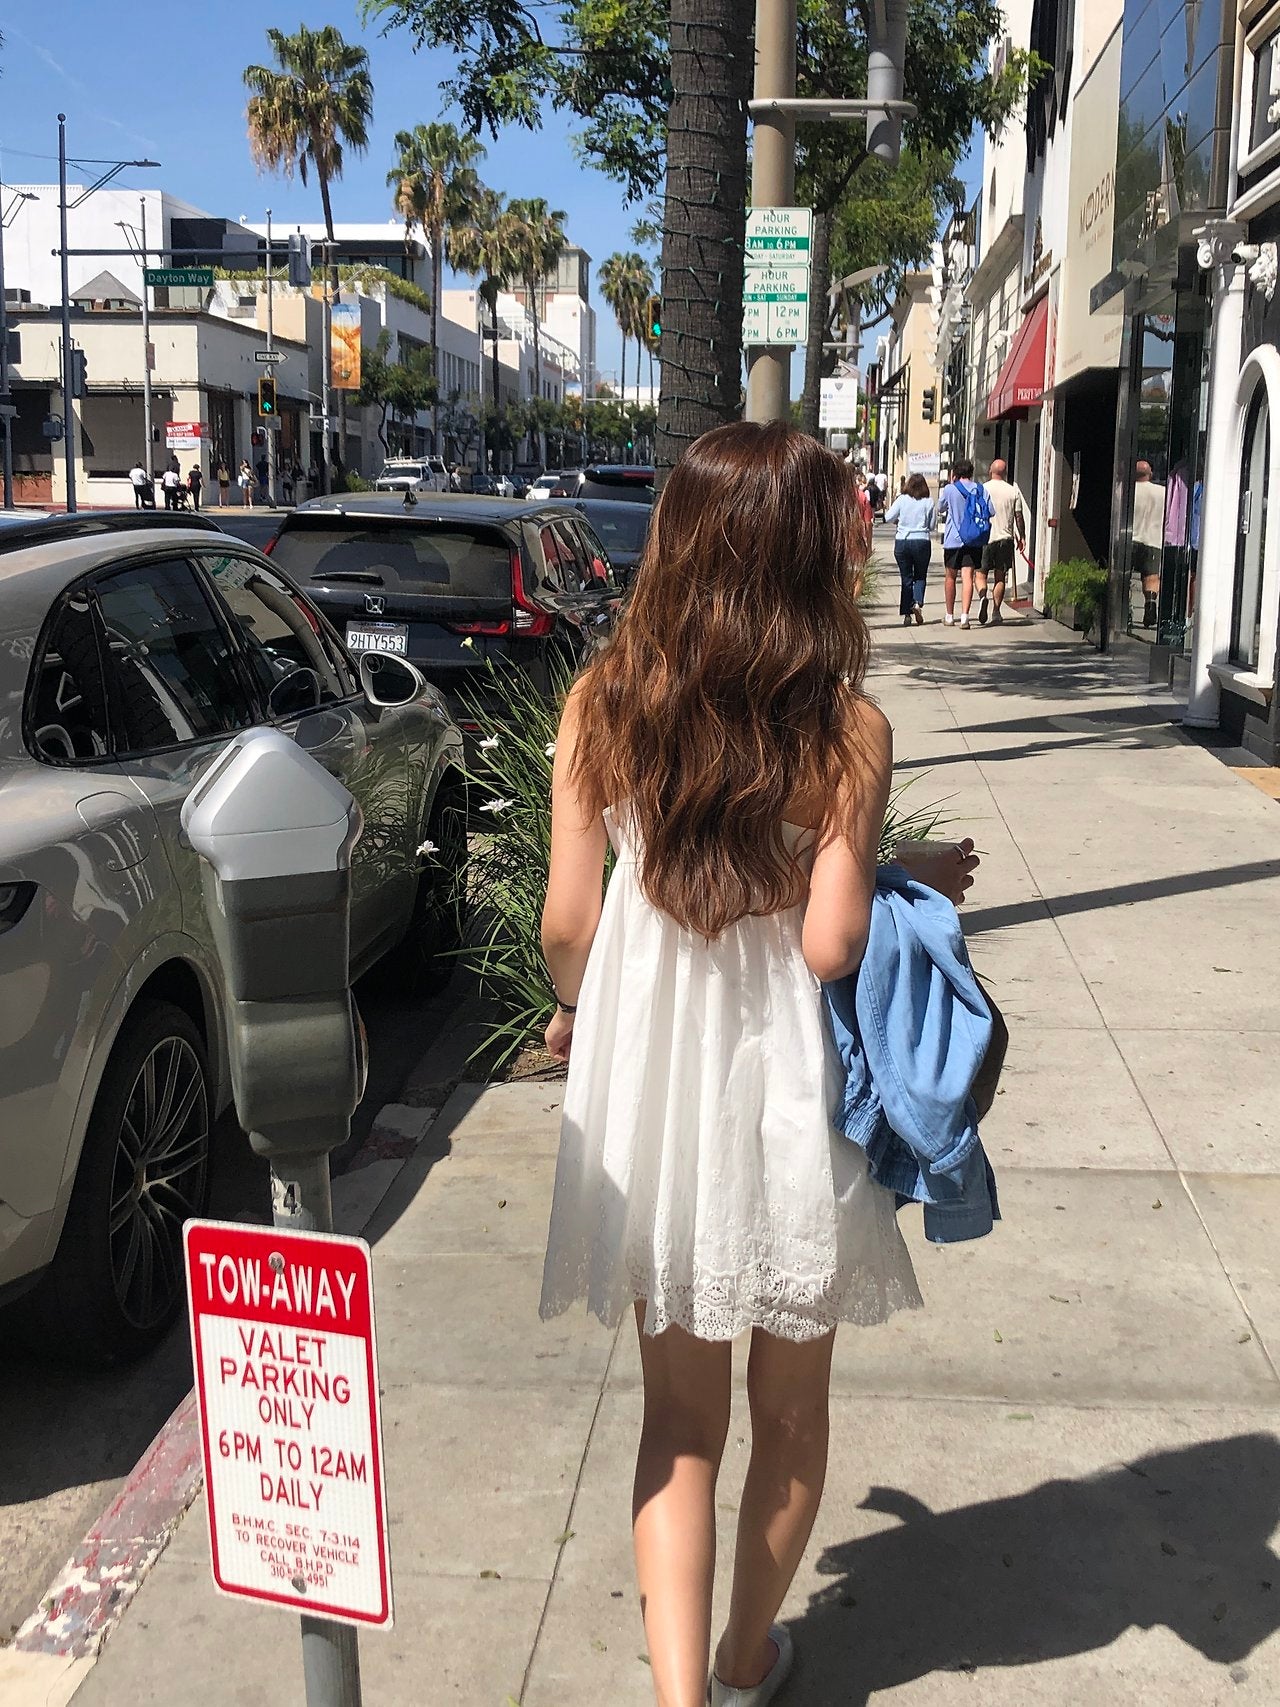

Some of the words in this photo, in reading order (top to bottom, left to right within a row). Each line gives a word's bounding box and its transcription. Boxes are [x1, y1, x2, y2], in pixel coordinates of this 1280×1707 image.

[763, 213, 790, 223] HOUR
[755, 226, 798, 236] PARKING
[148, 273, 185, 285] Dayton
[188, 273, 210, 285] Way
[761, 271, 789, 281] HOUR
[753, 283, 796, 293] PARKING
[776, 294, 798, 302] SUNDAY
[350, 633, 404, 651] 9HTY553
[199, 1252, 357, 1321] TOW-AWAY
[237, 1326, 327, 1368] VALET
[220, 1357, 351, 1405] PARKING
[258, 1396, 315, 1431] ONLY
[274, 1438, 302, 1471] TO
[311, 1446, 367, 1484] 12AM
[260, 1473, 325, 1512] DAILY
[232, 1513, 278, 1533] B.H.M.C.
[285, 1523, 313, 1539] SEC.
[236, 1529, 250, 1543] TO
[256, 1533, 307, 1554] RECOVER
[312, 1544, 359, 1565] VEHICLE
[260, 1550, 289, 1566] CALL
